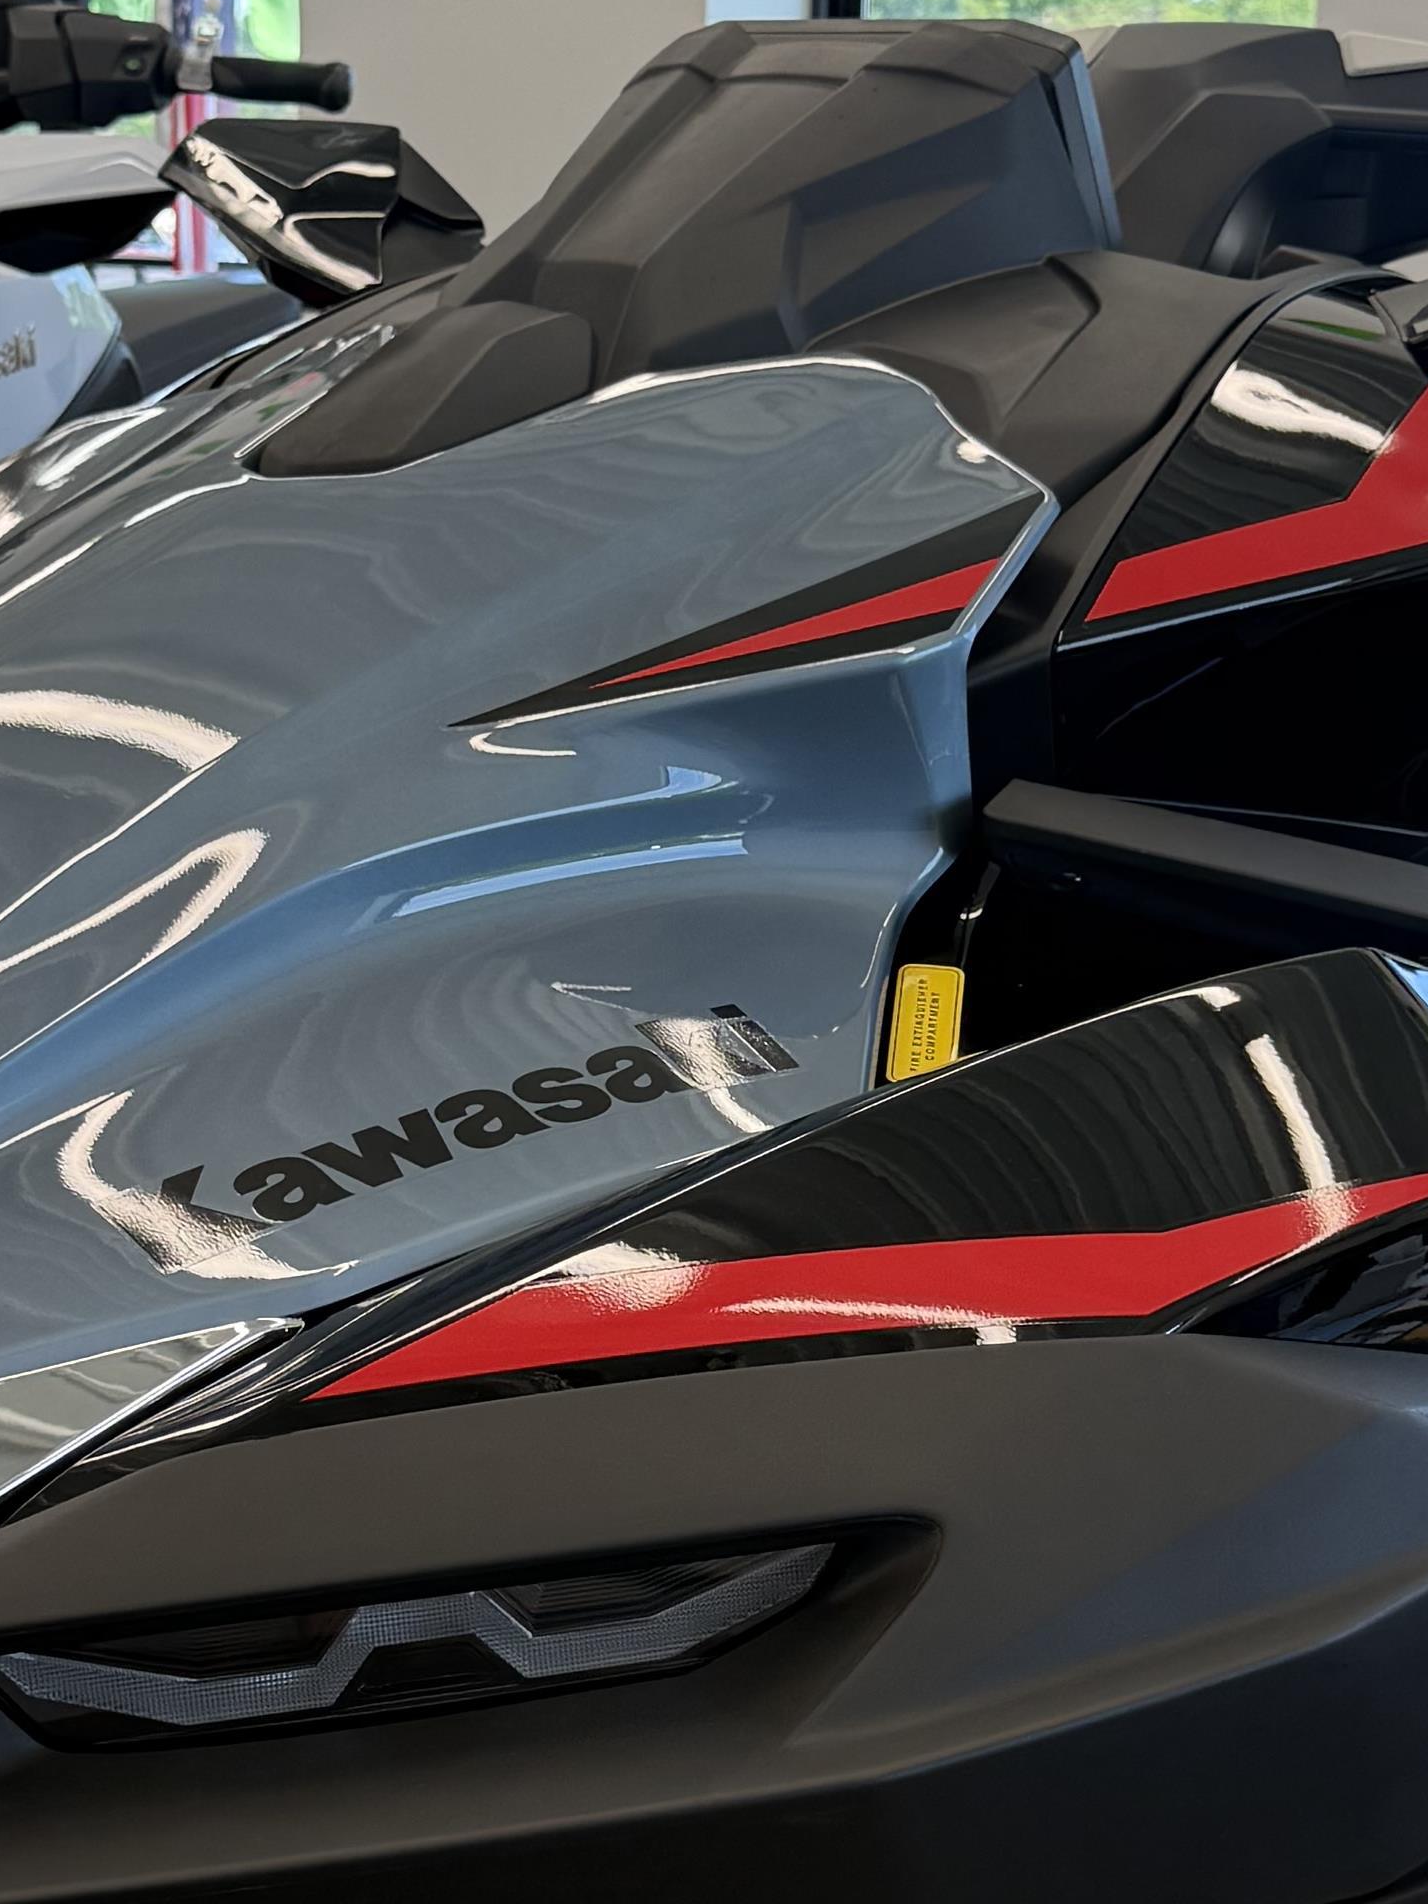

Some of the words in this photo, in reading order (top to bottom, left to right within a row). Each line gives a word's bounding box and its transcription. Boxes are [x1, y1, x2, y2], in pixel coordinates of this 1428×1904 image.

[910, 1049, 921, 1072] FIRE
[925, 992, 940, 1061] COMPARTMENT
[97, 1004, 799, 1274] Kawasaki
